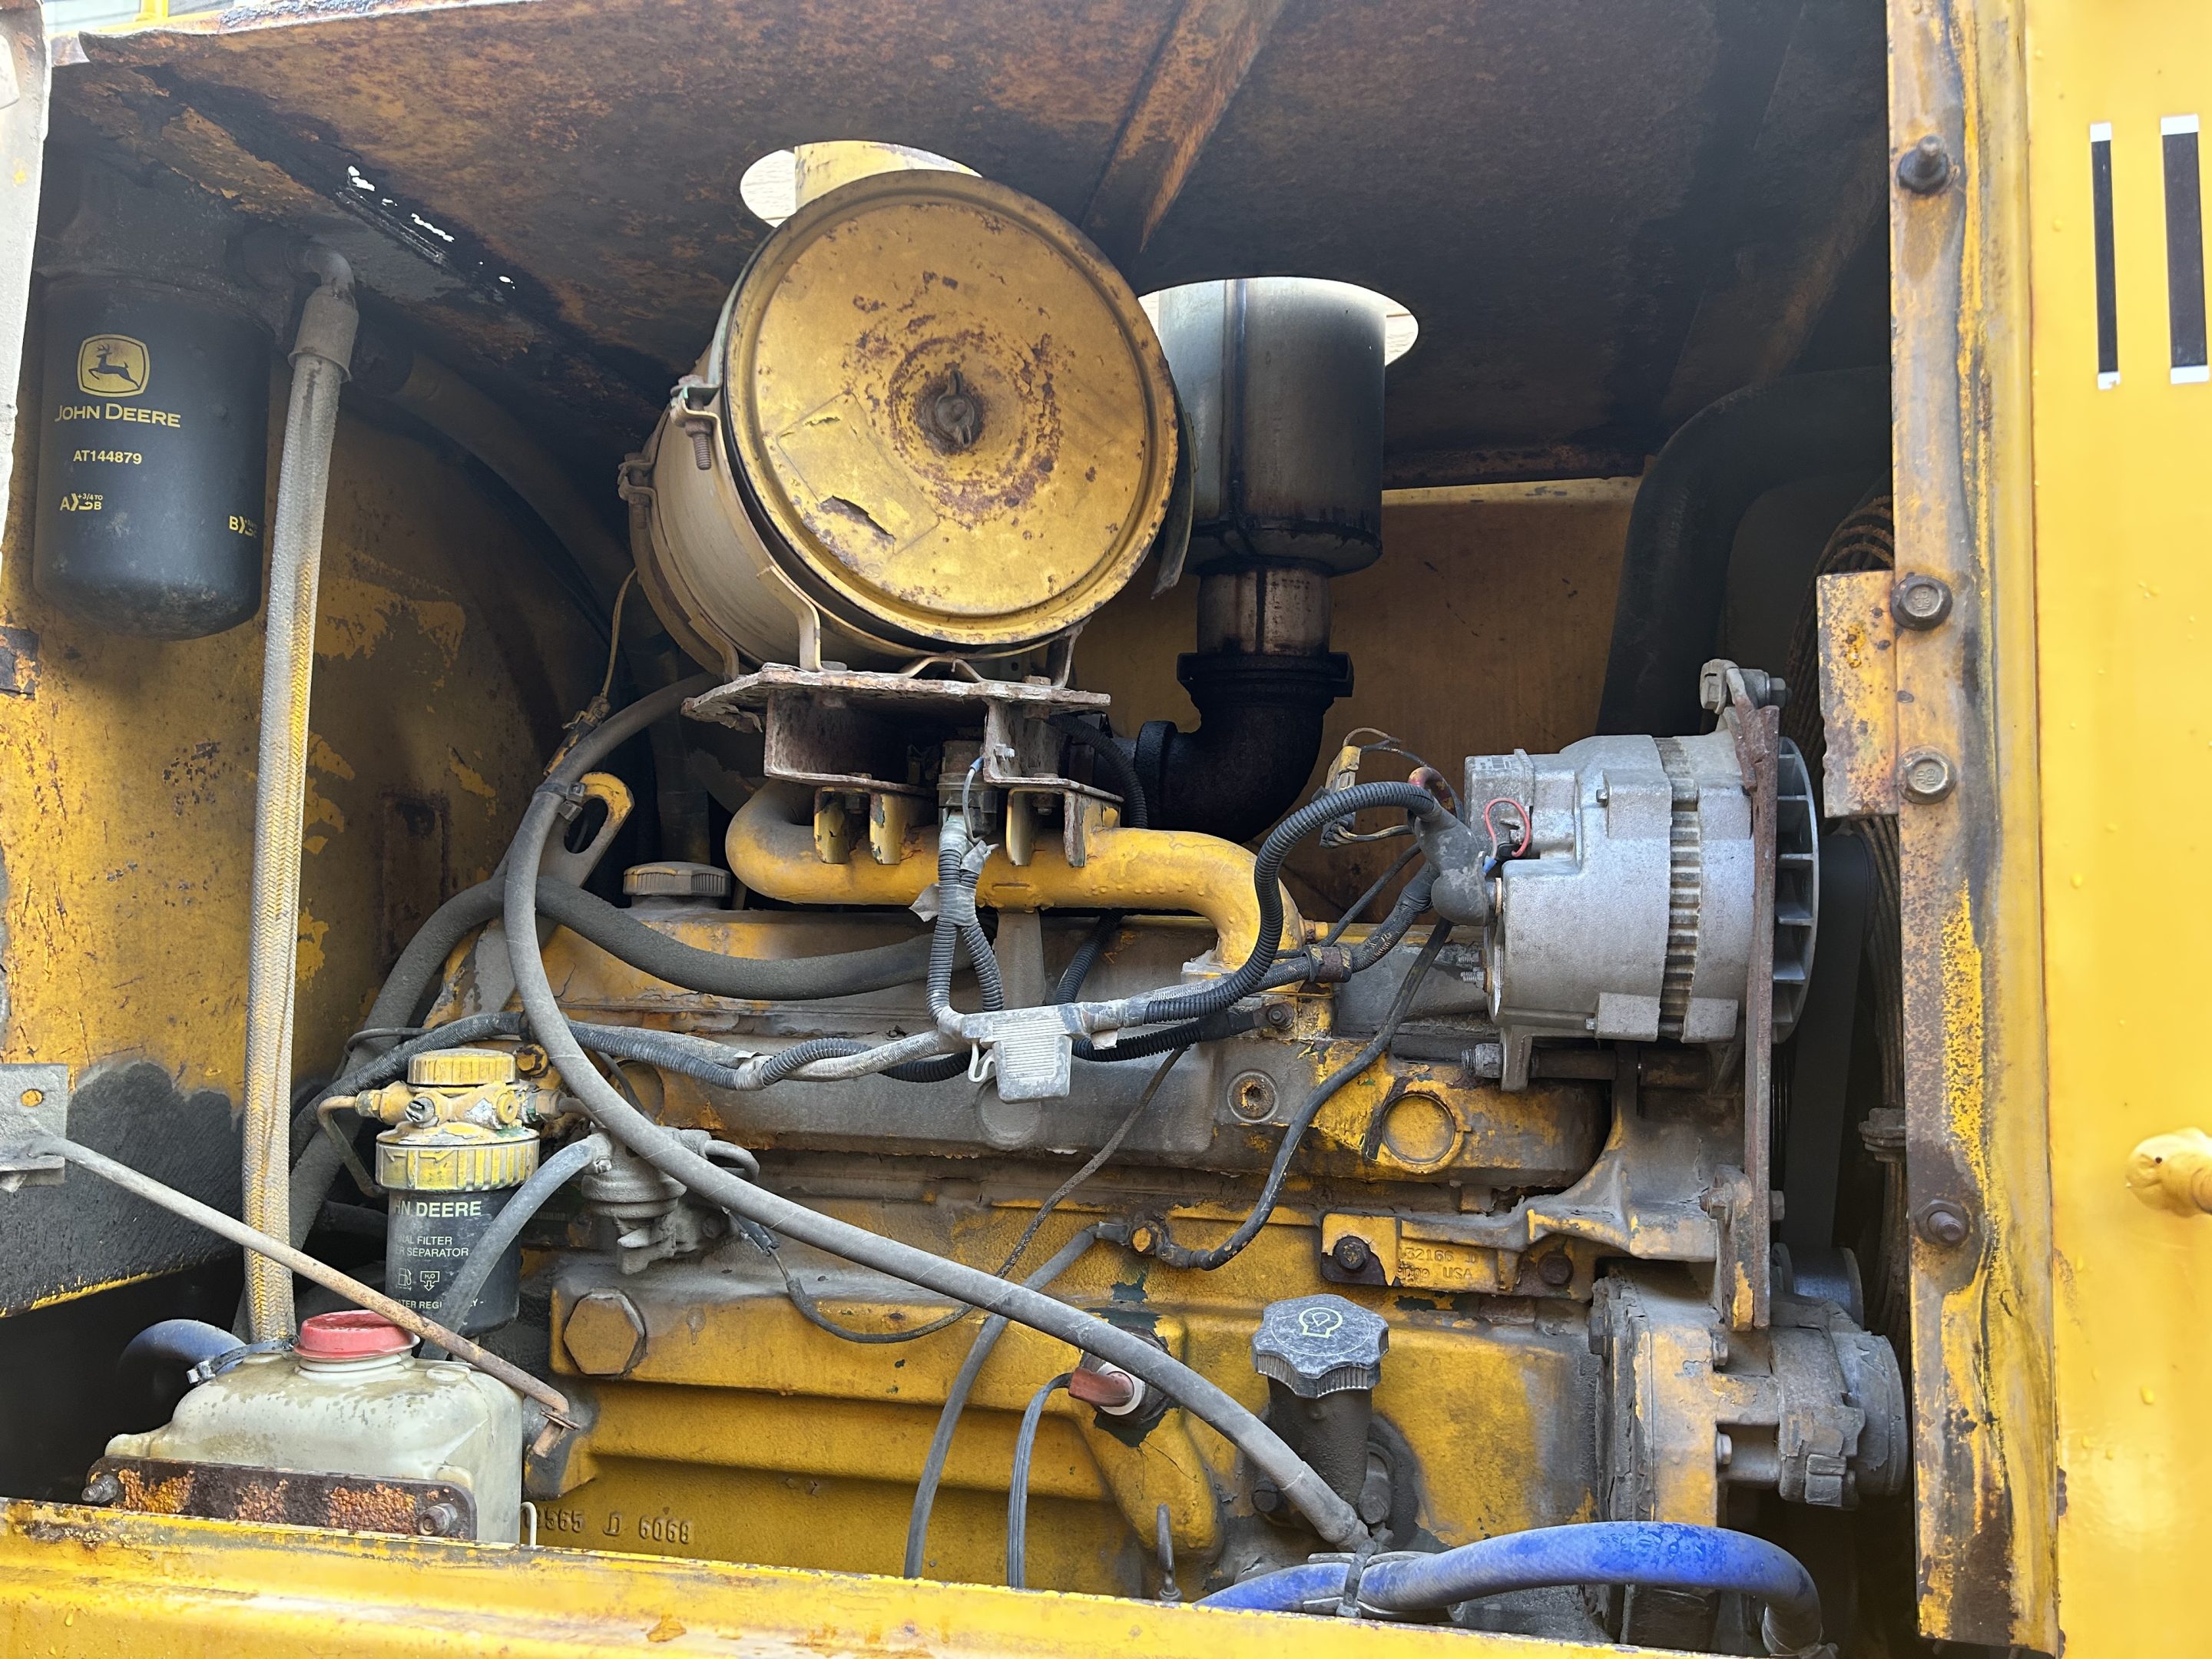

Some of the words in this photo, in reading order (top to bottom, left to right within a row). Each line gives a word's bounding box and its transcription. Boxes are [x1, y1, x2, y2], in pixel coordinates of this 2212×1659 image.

[55, 405, 100, 422] JOHN
[105, 403, 180, 428] DEERE
[73, 450, 142, 465] AT144879
[395, 1200, 411, 1216] HN
[416, 1200, 482, 1217] DEERE
[417, 1236, 453, 1245] FILTER
[406, 1247, 469, 1257] SEPARATOR
[1443, 1267, 1472, 1280] USA
[639, 1515, 691, 1545] 6068
